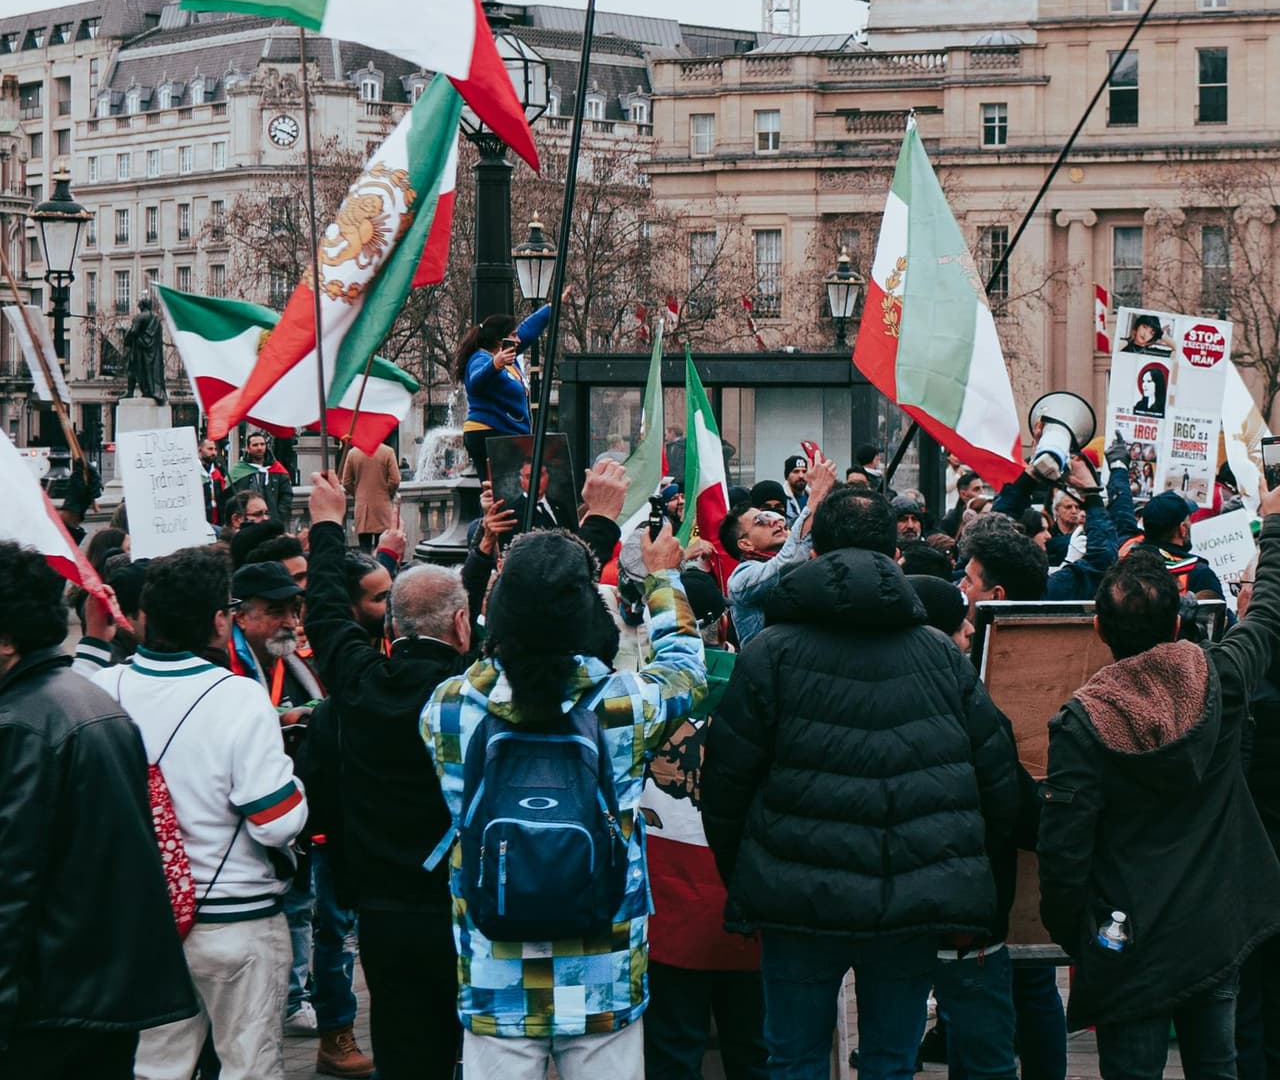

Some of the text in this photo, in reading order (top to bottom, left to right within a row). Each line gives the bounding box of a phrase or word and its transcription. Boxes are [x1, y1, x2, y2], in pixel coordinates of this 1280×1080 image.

[1188, 329, 1222, 344] STOP
[1190, 354, 1215, 366] IRAN
[1134, 424, 1159, 441] IRGC
[1173, 422, 1197, 439] IRGC
[1172, 438, 1208, 453] TERRORIST
[1195, 530, 1244, 552] WOMAN
[1215, 552, 1237, 567] LIFE
